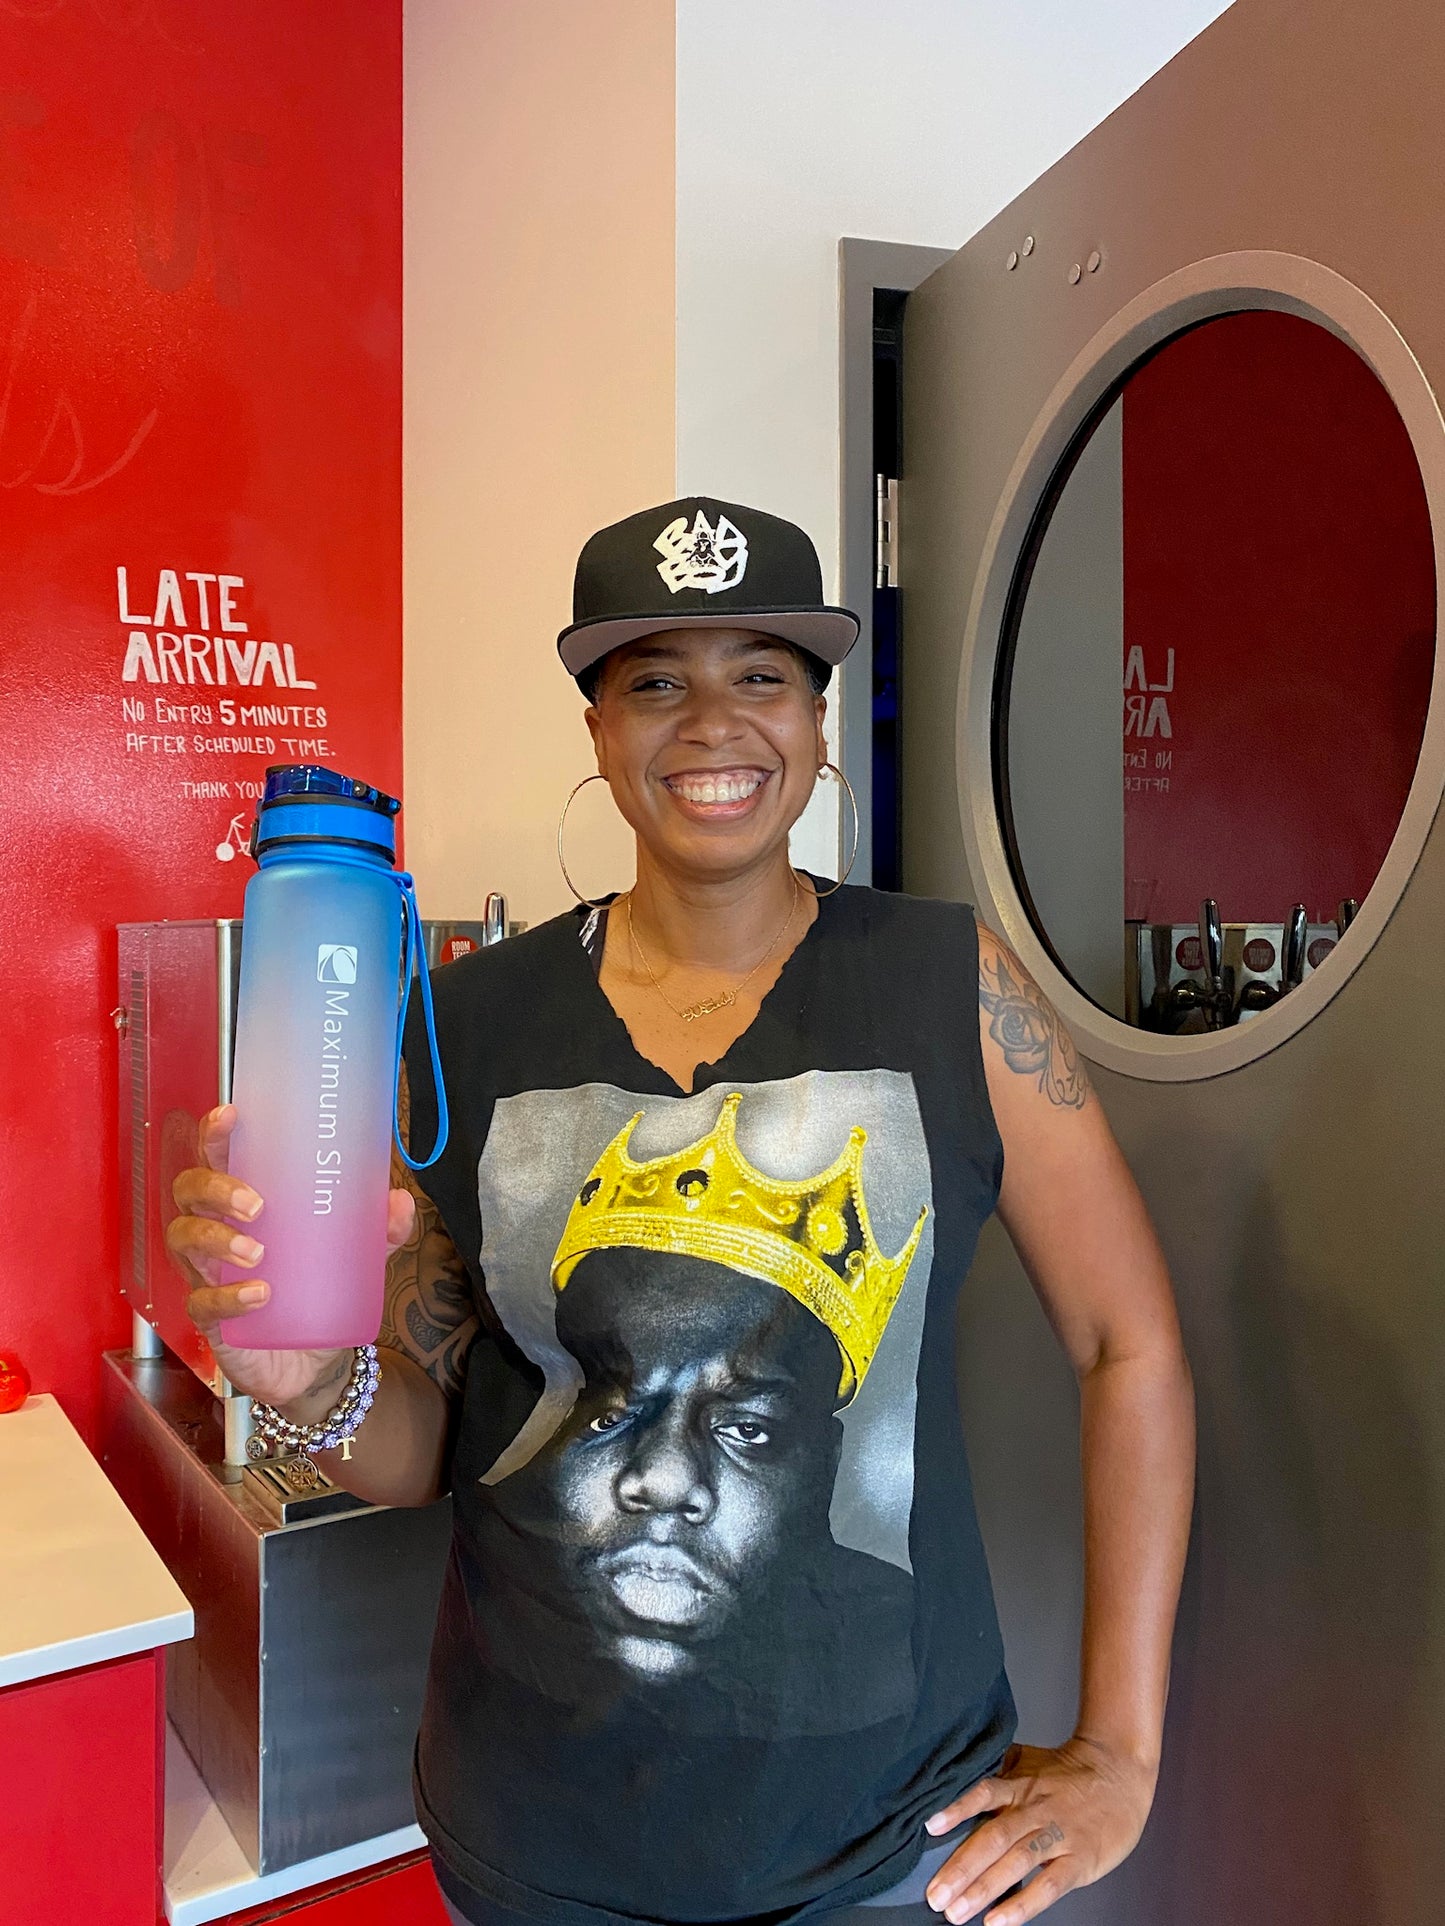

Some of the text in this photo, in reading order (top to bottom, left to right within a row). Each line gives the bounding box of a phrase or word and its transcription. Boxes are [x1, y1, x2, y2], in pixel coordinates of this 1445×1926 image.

[117, 566, 248, 632] LATE
[122, 631, 317, 690] ARRIVAL
[122, 697, 327, 727] NO ENTRY 5 MINUTES
[126, 733, 336, 756] AFTER SCHEDULED TIME.
[181, 781, 263, 799] THANK YOU
[452, 941, 470, 951] ROOM
[313, 990, 350, 1216] Maximum Slim
